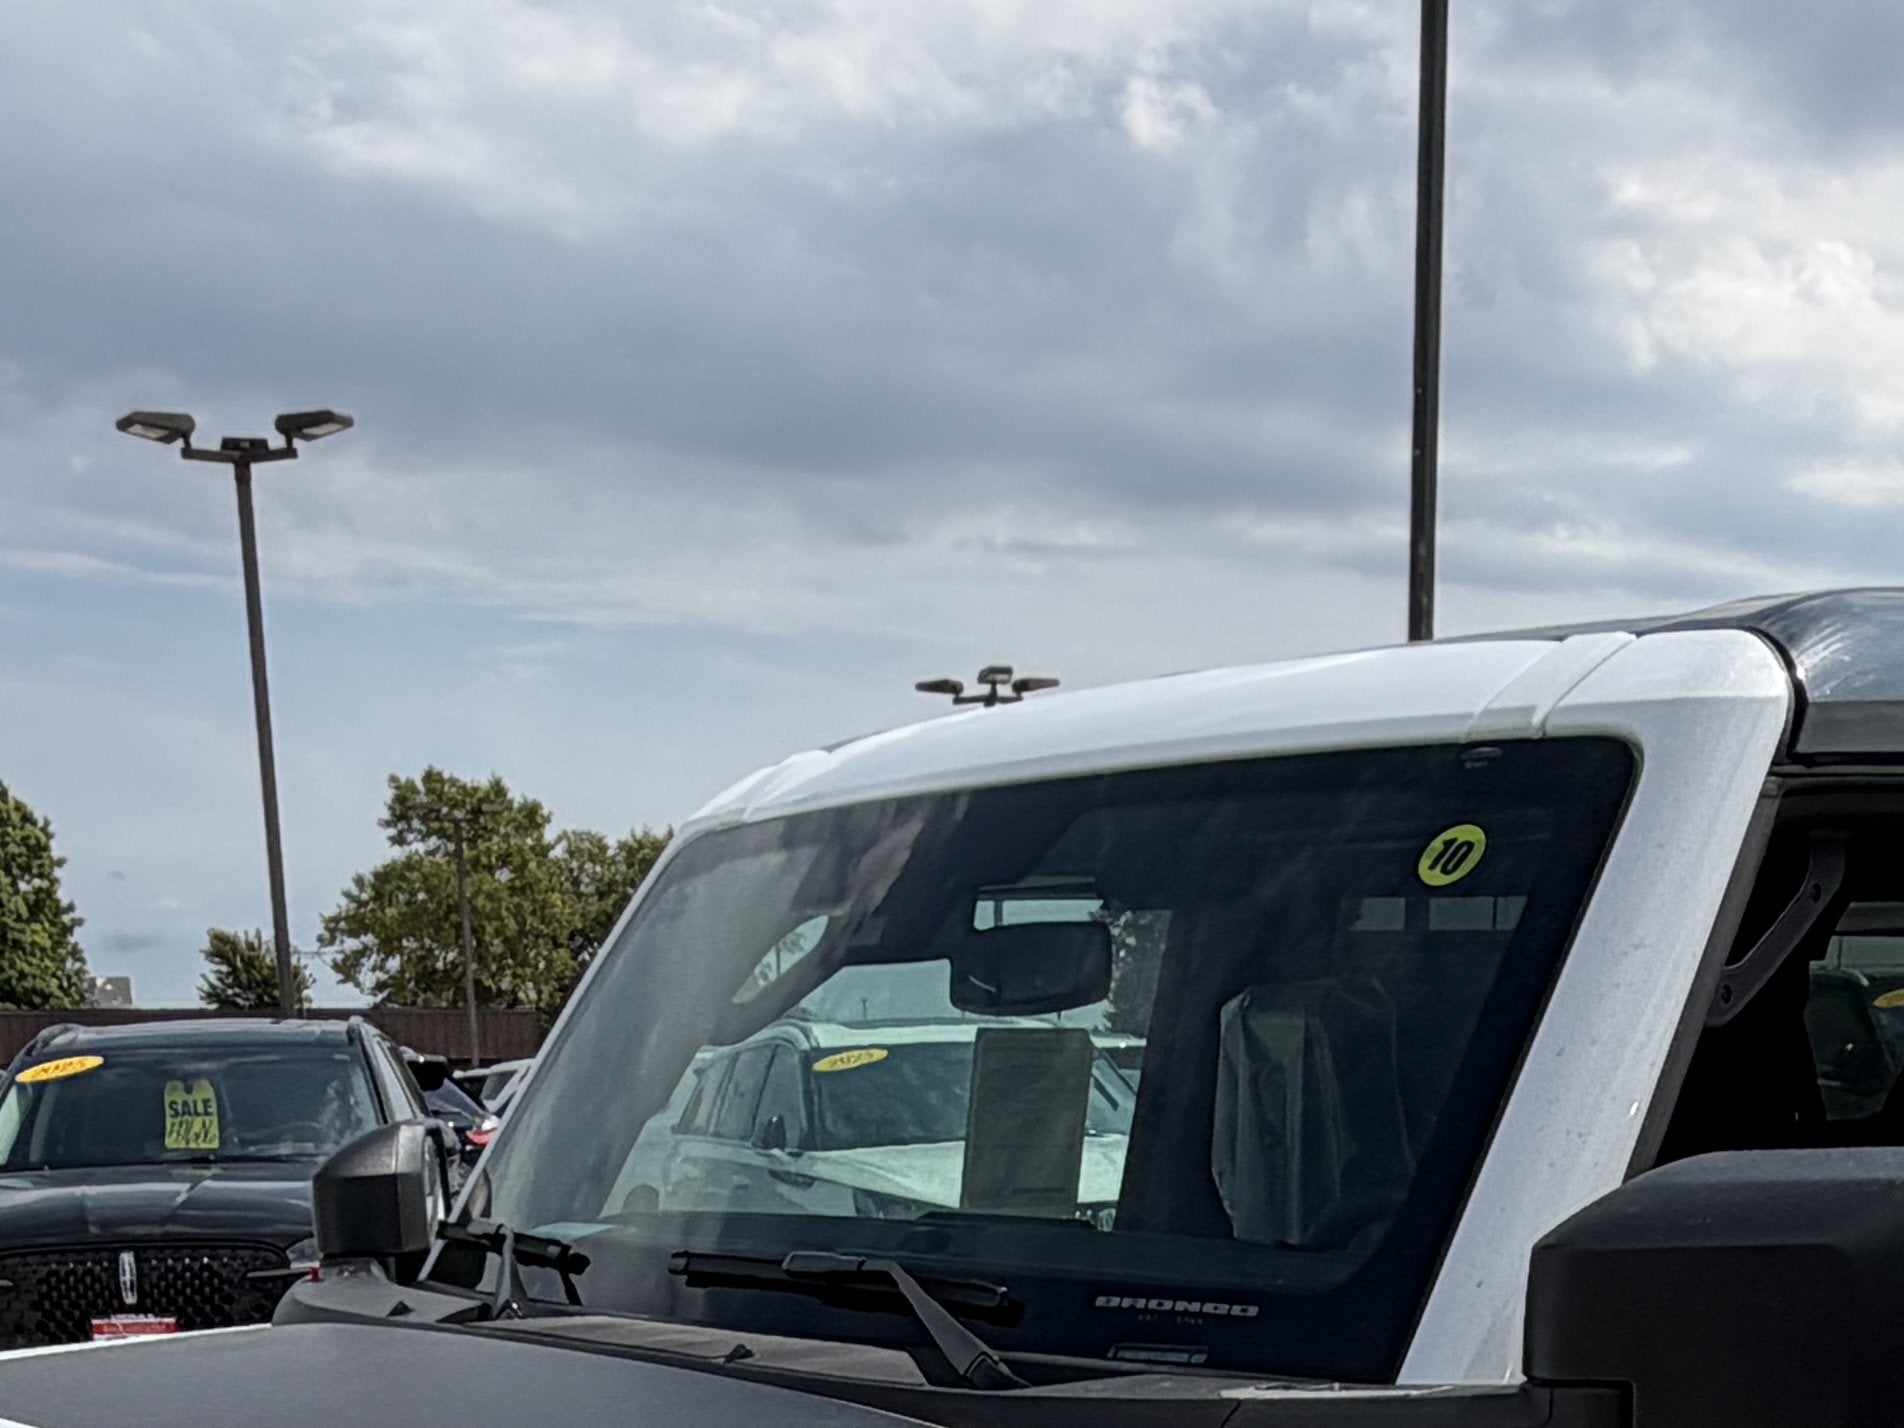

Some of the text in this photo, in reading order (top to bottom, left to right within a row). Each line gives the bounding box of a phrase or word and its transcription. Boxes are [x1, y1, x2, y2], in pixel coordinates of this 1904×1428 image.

[1427, 837, 1475, 876] 10
[168, 1098, 214, 1119] SALE
[1095, 1295, 1260, 1317] BRONCO
